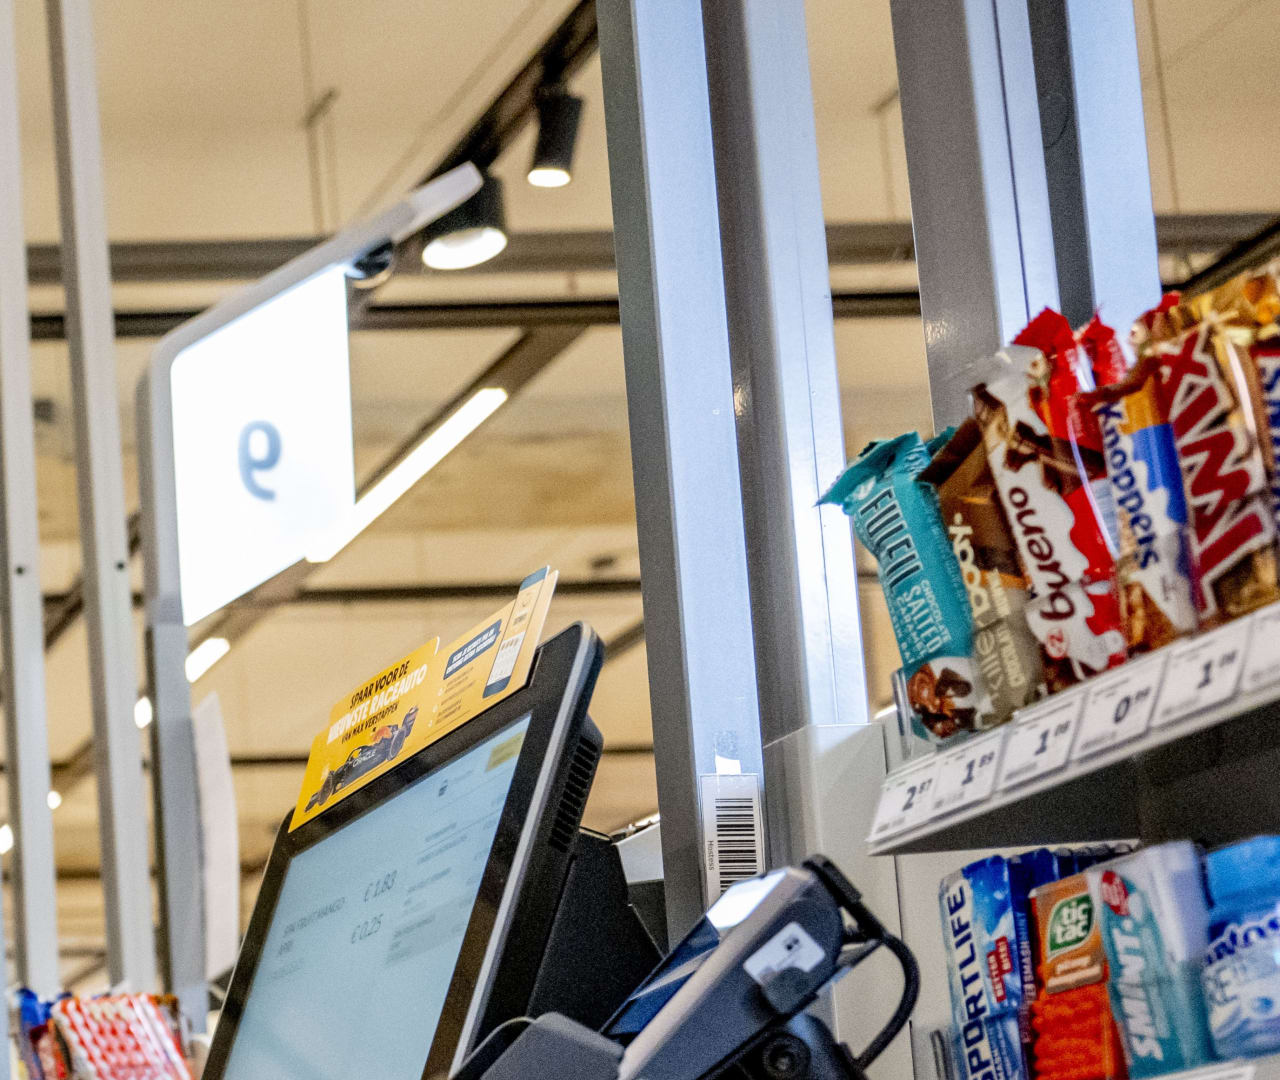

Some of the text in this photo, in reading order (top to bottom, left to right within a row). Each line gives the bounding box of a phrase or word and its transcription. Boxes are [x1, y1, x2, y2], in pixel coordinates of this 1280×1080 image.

[1167, 328, 1268, 617] TWIX
[858, 486, 924, 594] FULFIL
[1007, 486, 1075, 620] bueno
[902, 584, 943, 654] SALTED
[326, 699, 369, 745] NIEUWSTE
[369, 663, 428, 716] RACEAUTO
[349, 660, 410, 709] SPAAR VOOR DE
[351, 724, 365, 738] MAX
[364, 701, 400, 729] VERSTAPPEN
[707, 840, 715, 871] Hostess
[1053, 919, 1090, 946] tac
[1060, 899, 1091, 925] tic
